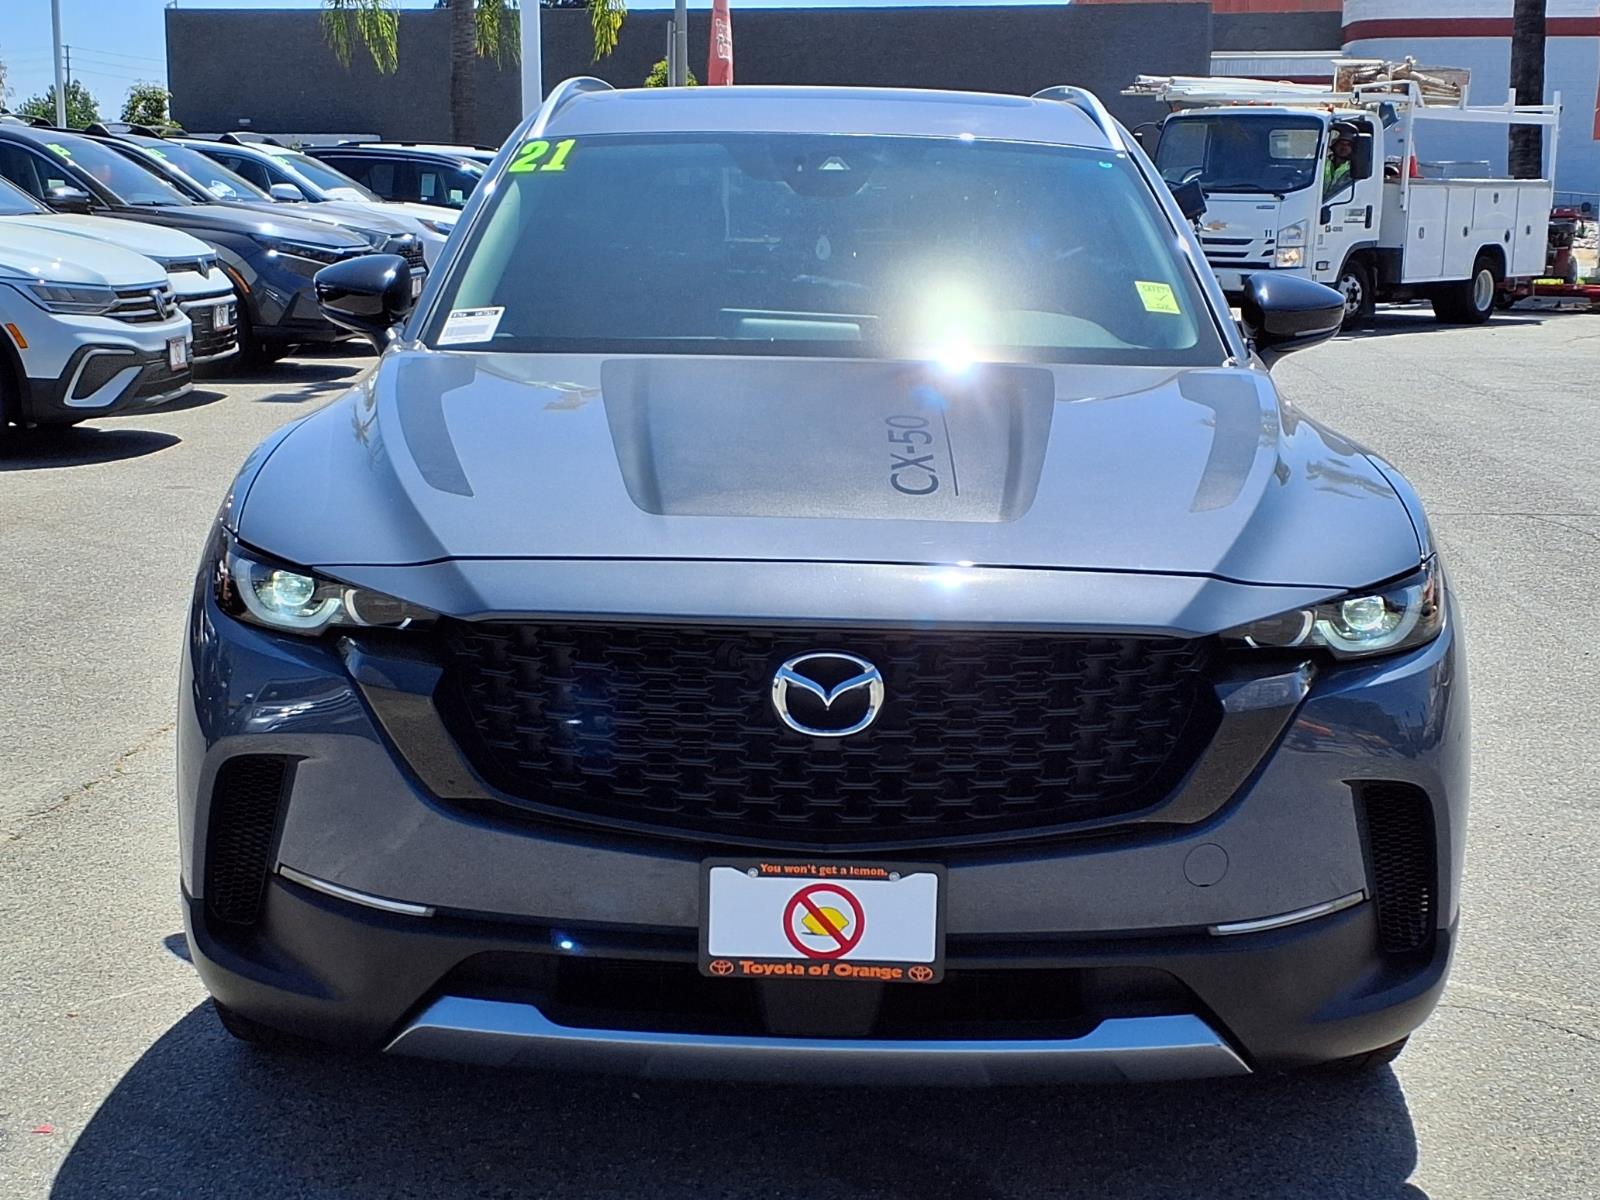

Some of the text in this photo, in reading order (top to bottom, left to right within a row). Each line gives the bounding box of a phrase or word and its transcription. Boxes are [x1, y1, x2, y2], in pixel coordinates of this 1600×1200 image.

[508, 139, 576, 172] 21
[885, 415, 939, 495] CX-50
[760, 863, 888, 877] You won't get a lemon.
[739, 960, 903, 980] Toyota of Orange
